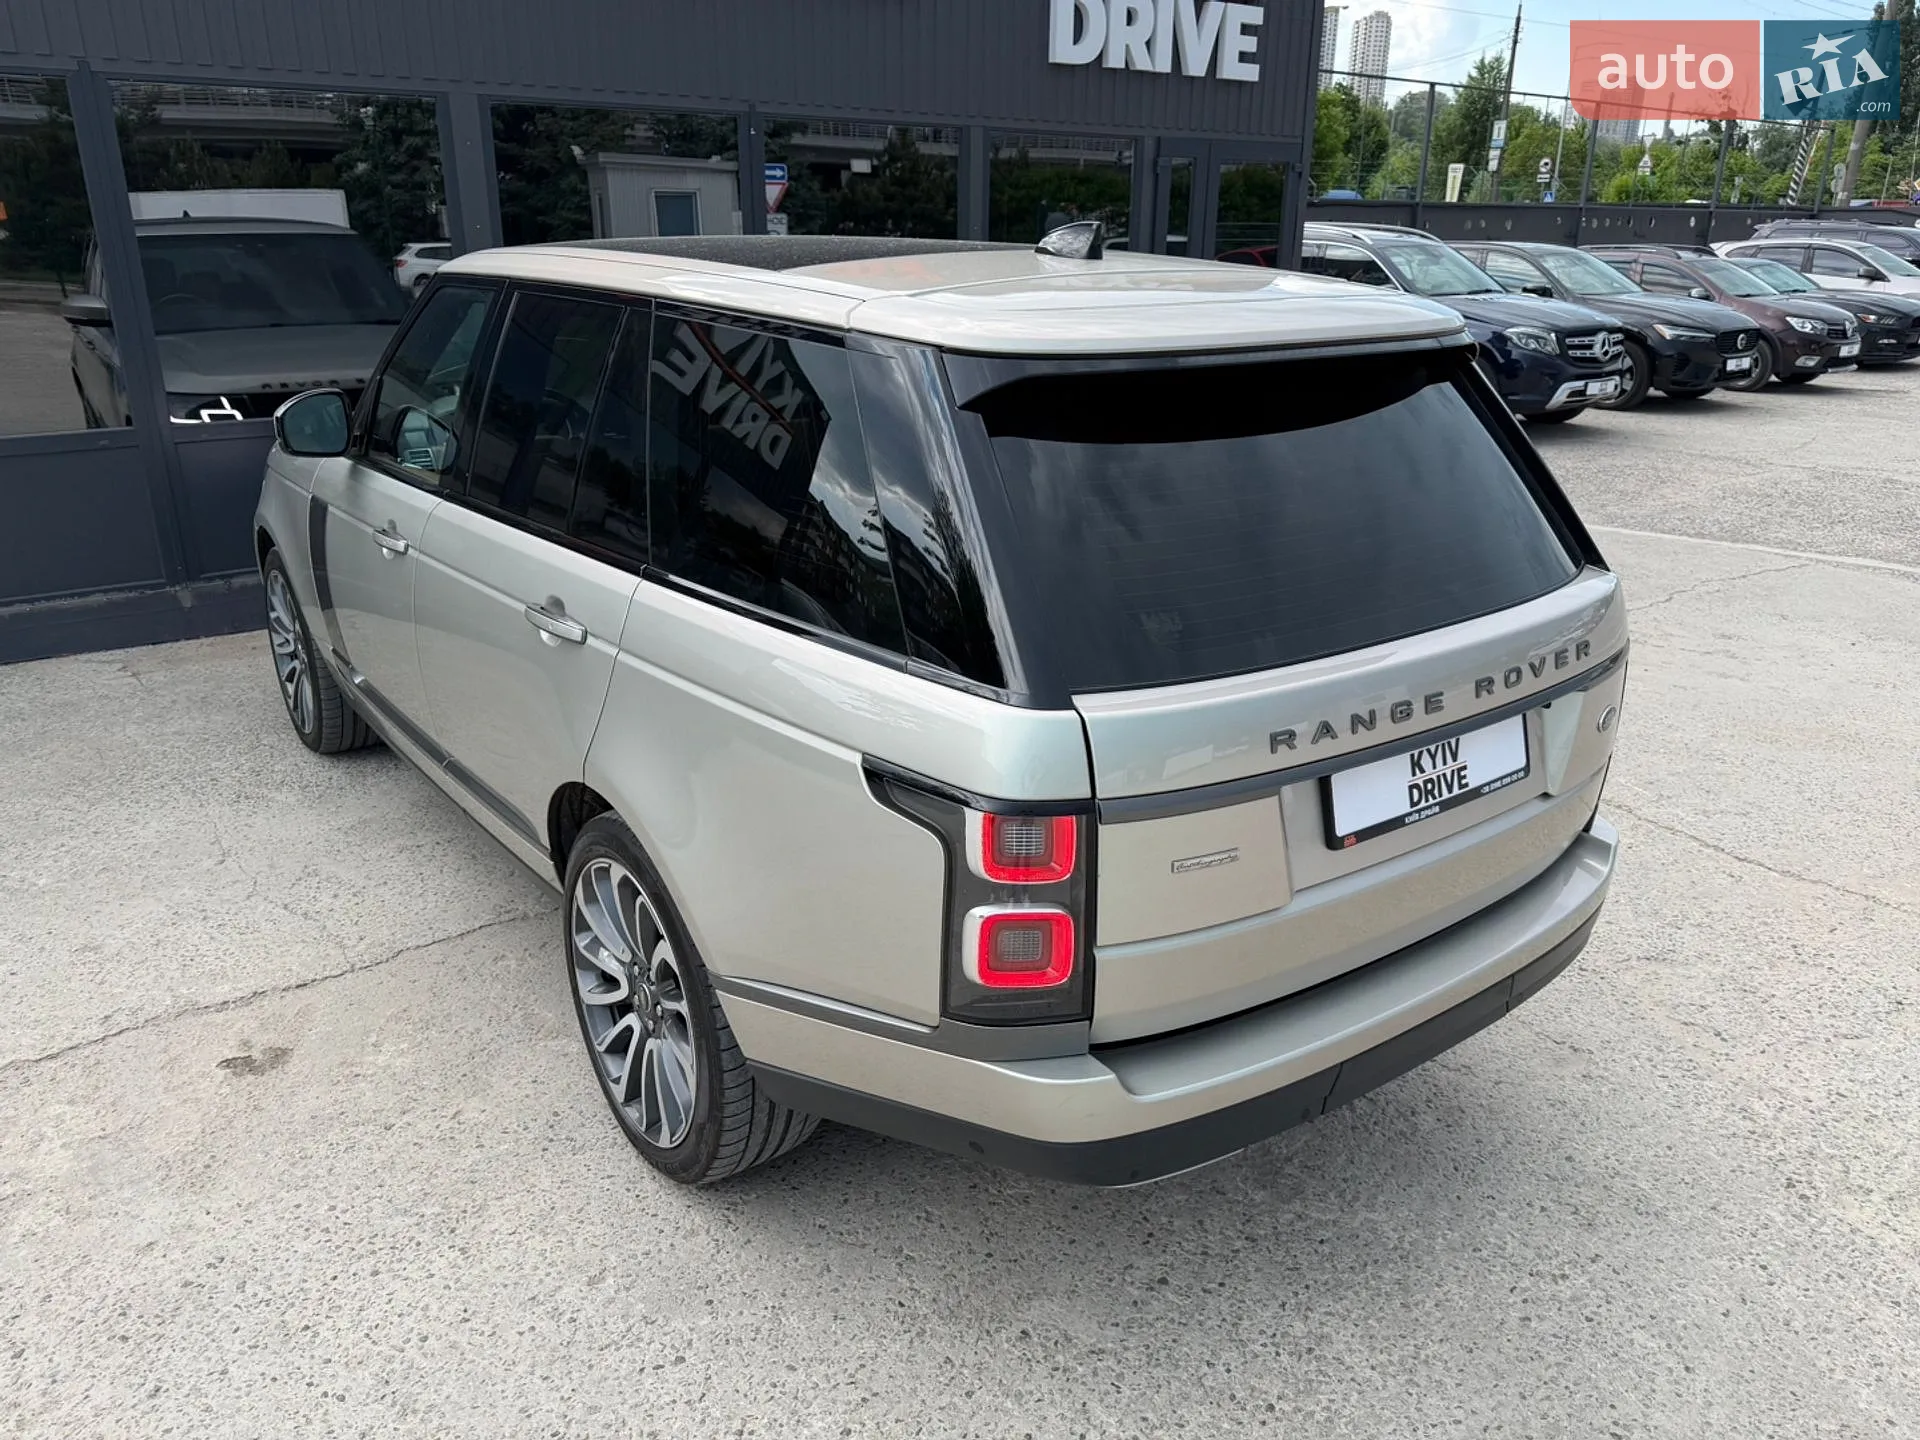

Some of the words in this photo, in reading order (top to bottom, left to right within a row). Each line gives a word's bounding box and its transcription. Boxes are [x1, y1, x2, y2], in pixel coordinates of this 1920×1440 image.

[1048, 0, 1264, 82] DRIVE
[1268, 690, 1445, 755] RANGE
[1474, 639, 1592, 699] ROVER
[1407, 764, 1470, 809] DRIVE
[1409, 737, 1461, 778] KYIV
